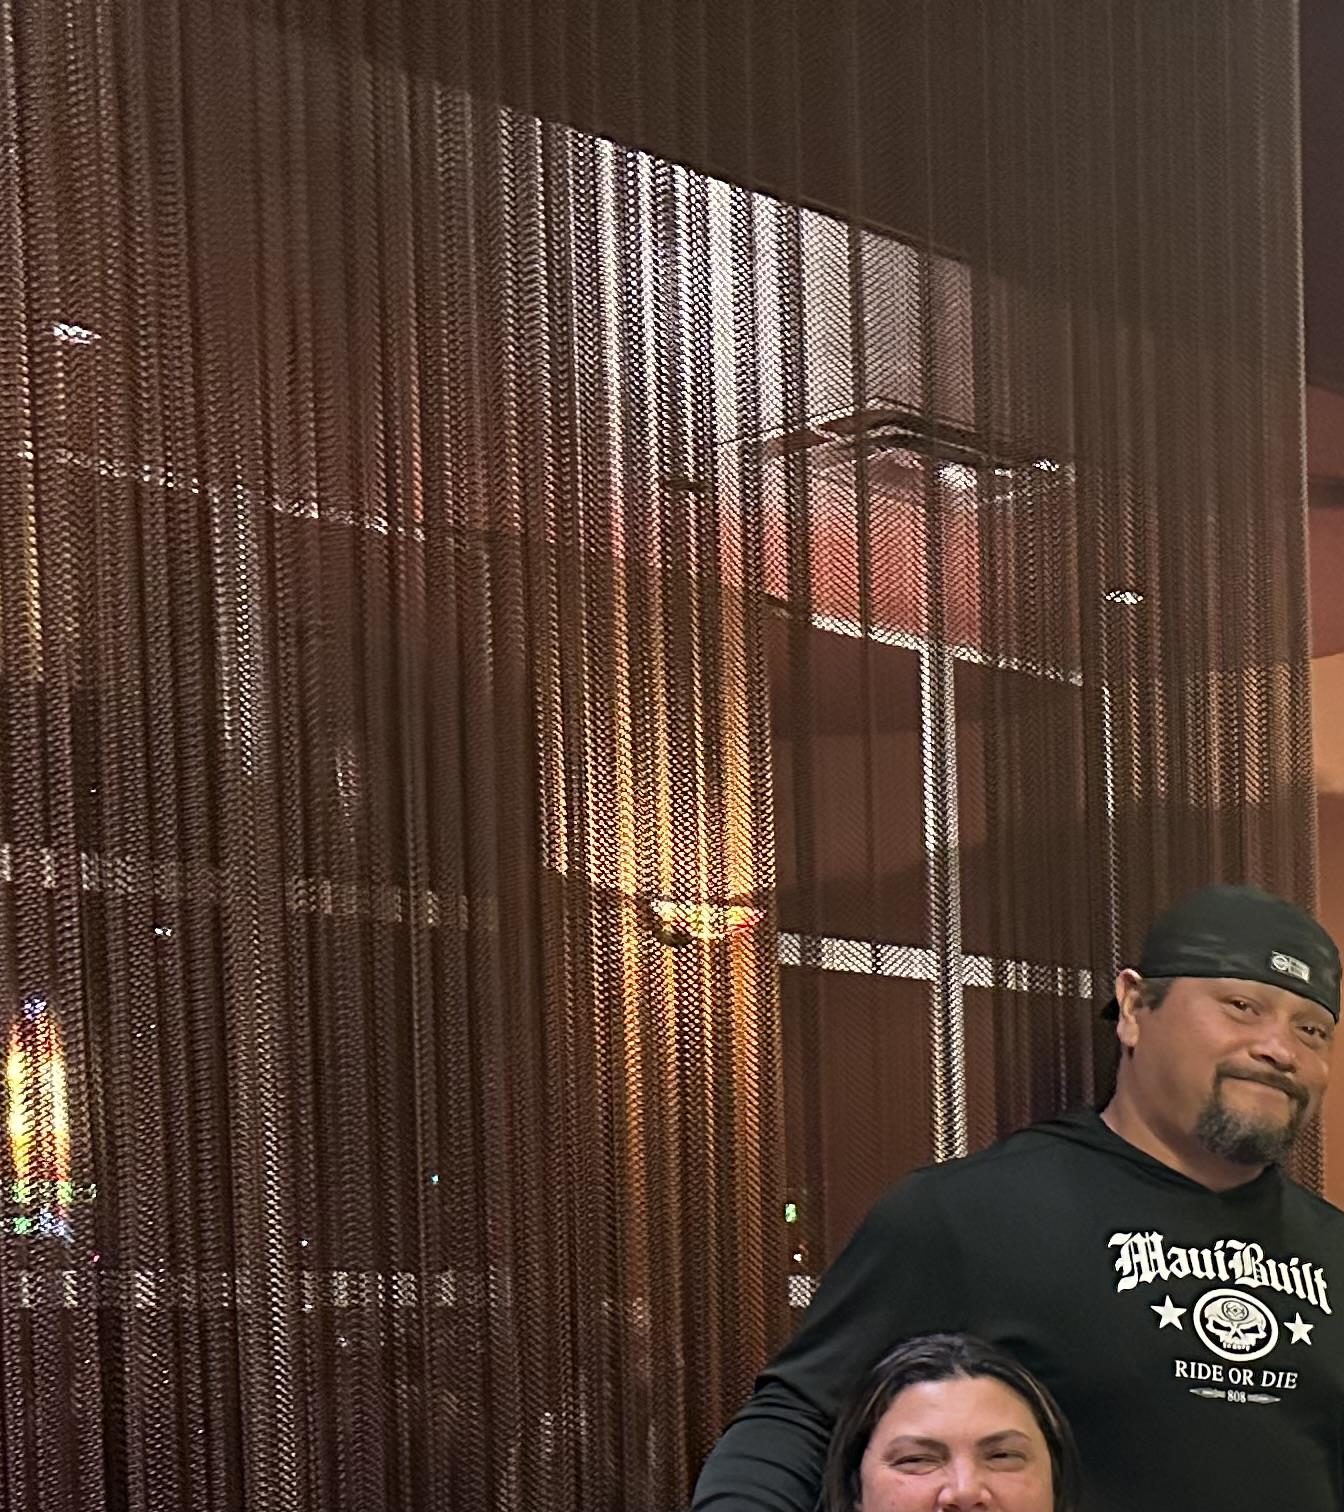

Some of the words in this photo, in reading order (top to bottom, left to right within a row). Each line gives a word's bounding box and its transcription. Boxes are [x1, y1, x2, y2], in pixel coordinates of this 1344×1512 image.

[1175, 1360, 1224, 1382] RIDE
[1228, 1367, 1254, 1386] OR
[1260, 1370, 1298, 1389] DIE
[1227, 1389, 1246, 1403] 808
